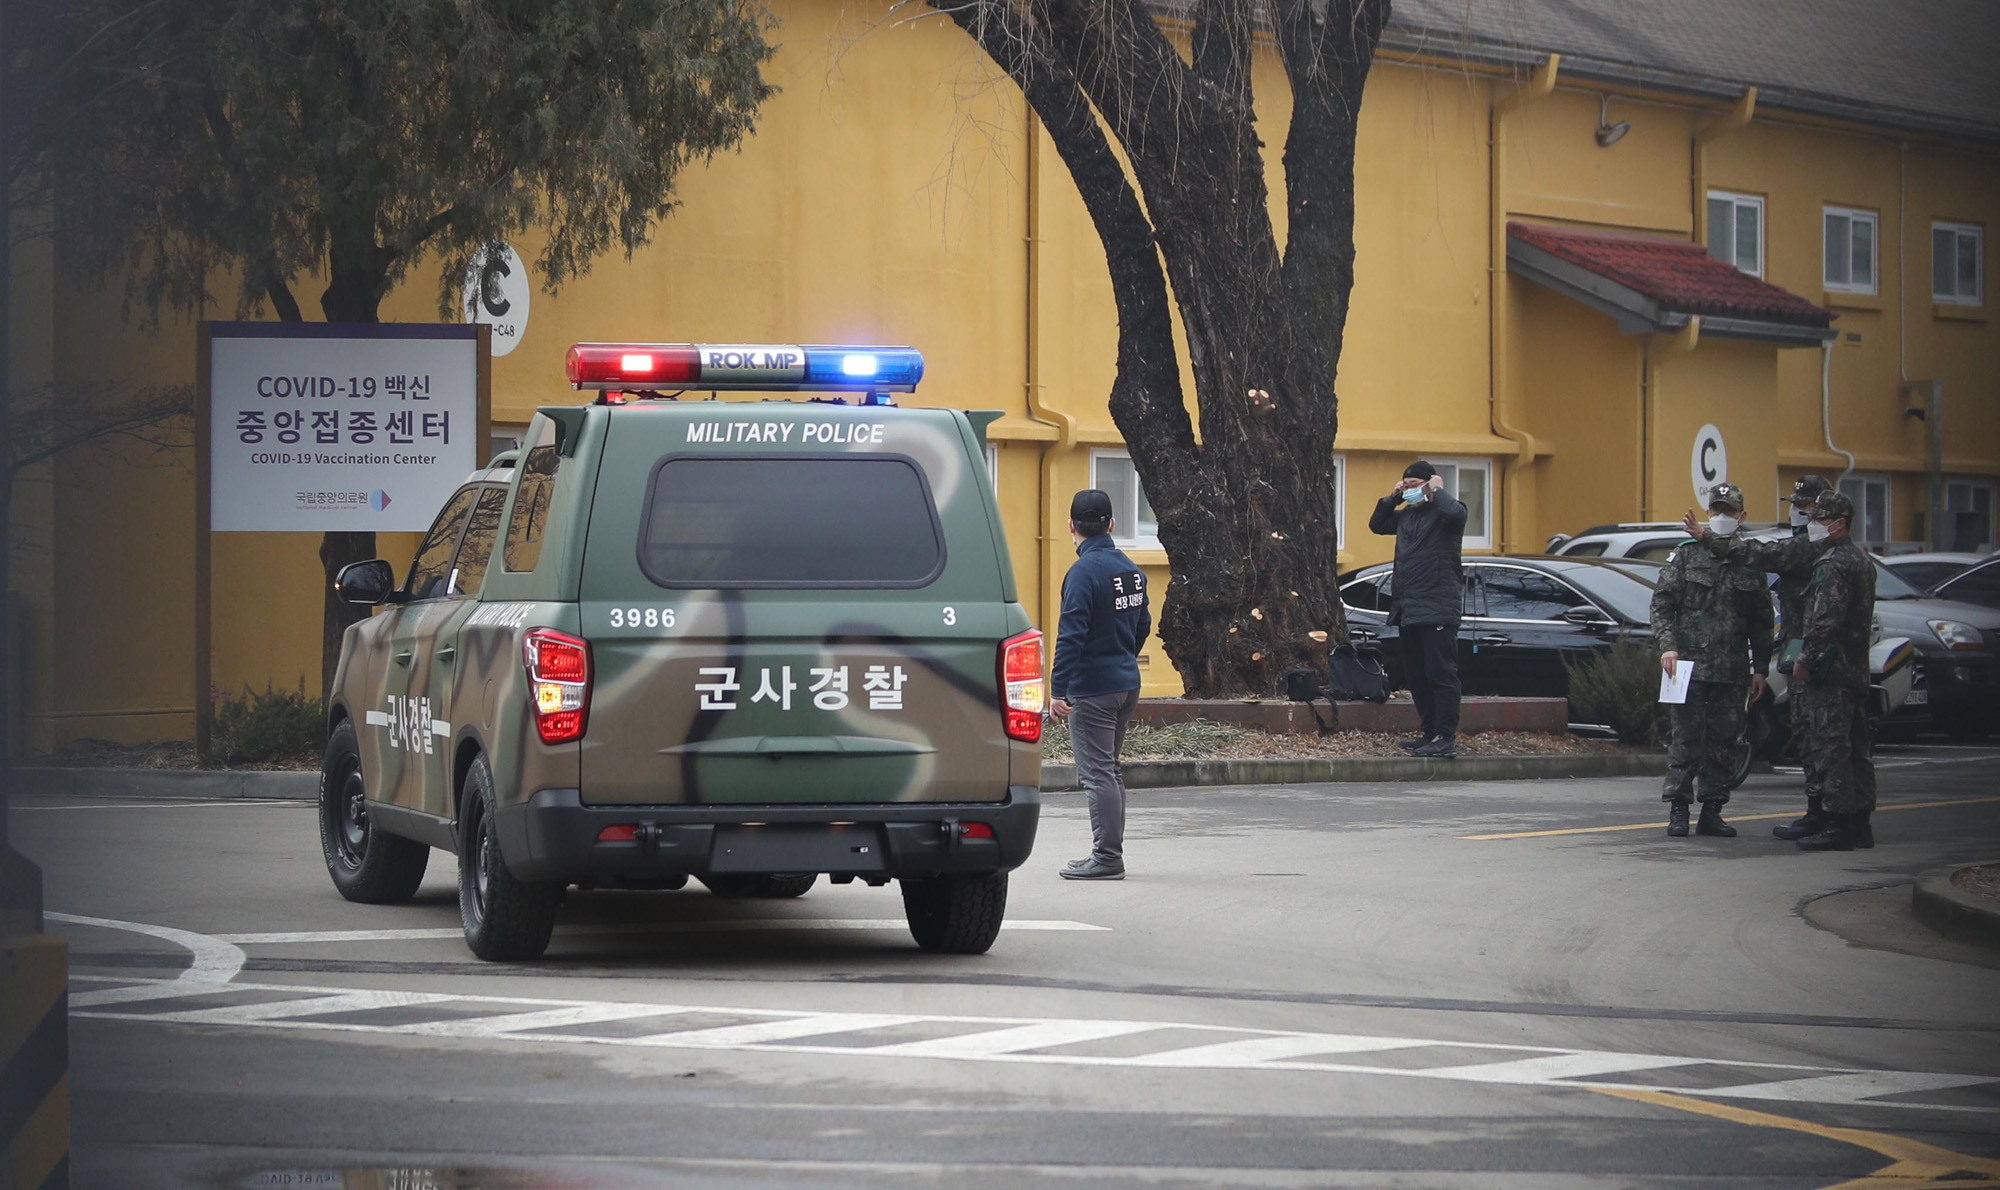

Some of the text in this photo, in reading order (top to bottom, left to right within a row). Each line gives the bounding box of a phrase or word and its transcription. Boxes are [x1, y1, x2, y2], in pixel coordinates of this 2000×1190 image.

[481, 257, 511, 317] C
[708, 351, 798, 371] ROK MP
[257, 374, 431, 401] COVID-19 백신
[235, 409, 451, 445] 중앙접종센터
[685, 421, 885, 444] MILITARY POLICE
[251, 452, 437, 465] COVID-19 Vaccination Center
[1701, 438, 1717, 481] C
[296, 492, 368, 504] 국립중앙의료원
[493, 603, 536, 628] POLICE
[609, 606, 957, 628] 3986 3
[694, 664, 909, 711] 군사경찰
[387, 694, 433, 755] 군사경찰
